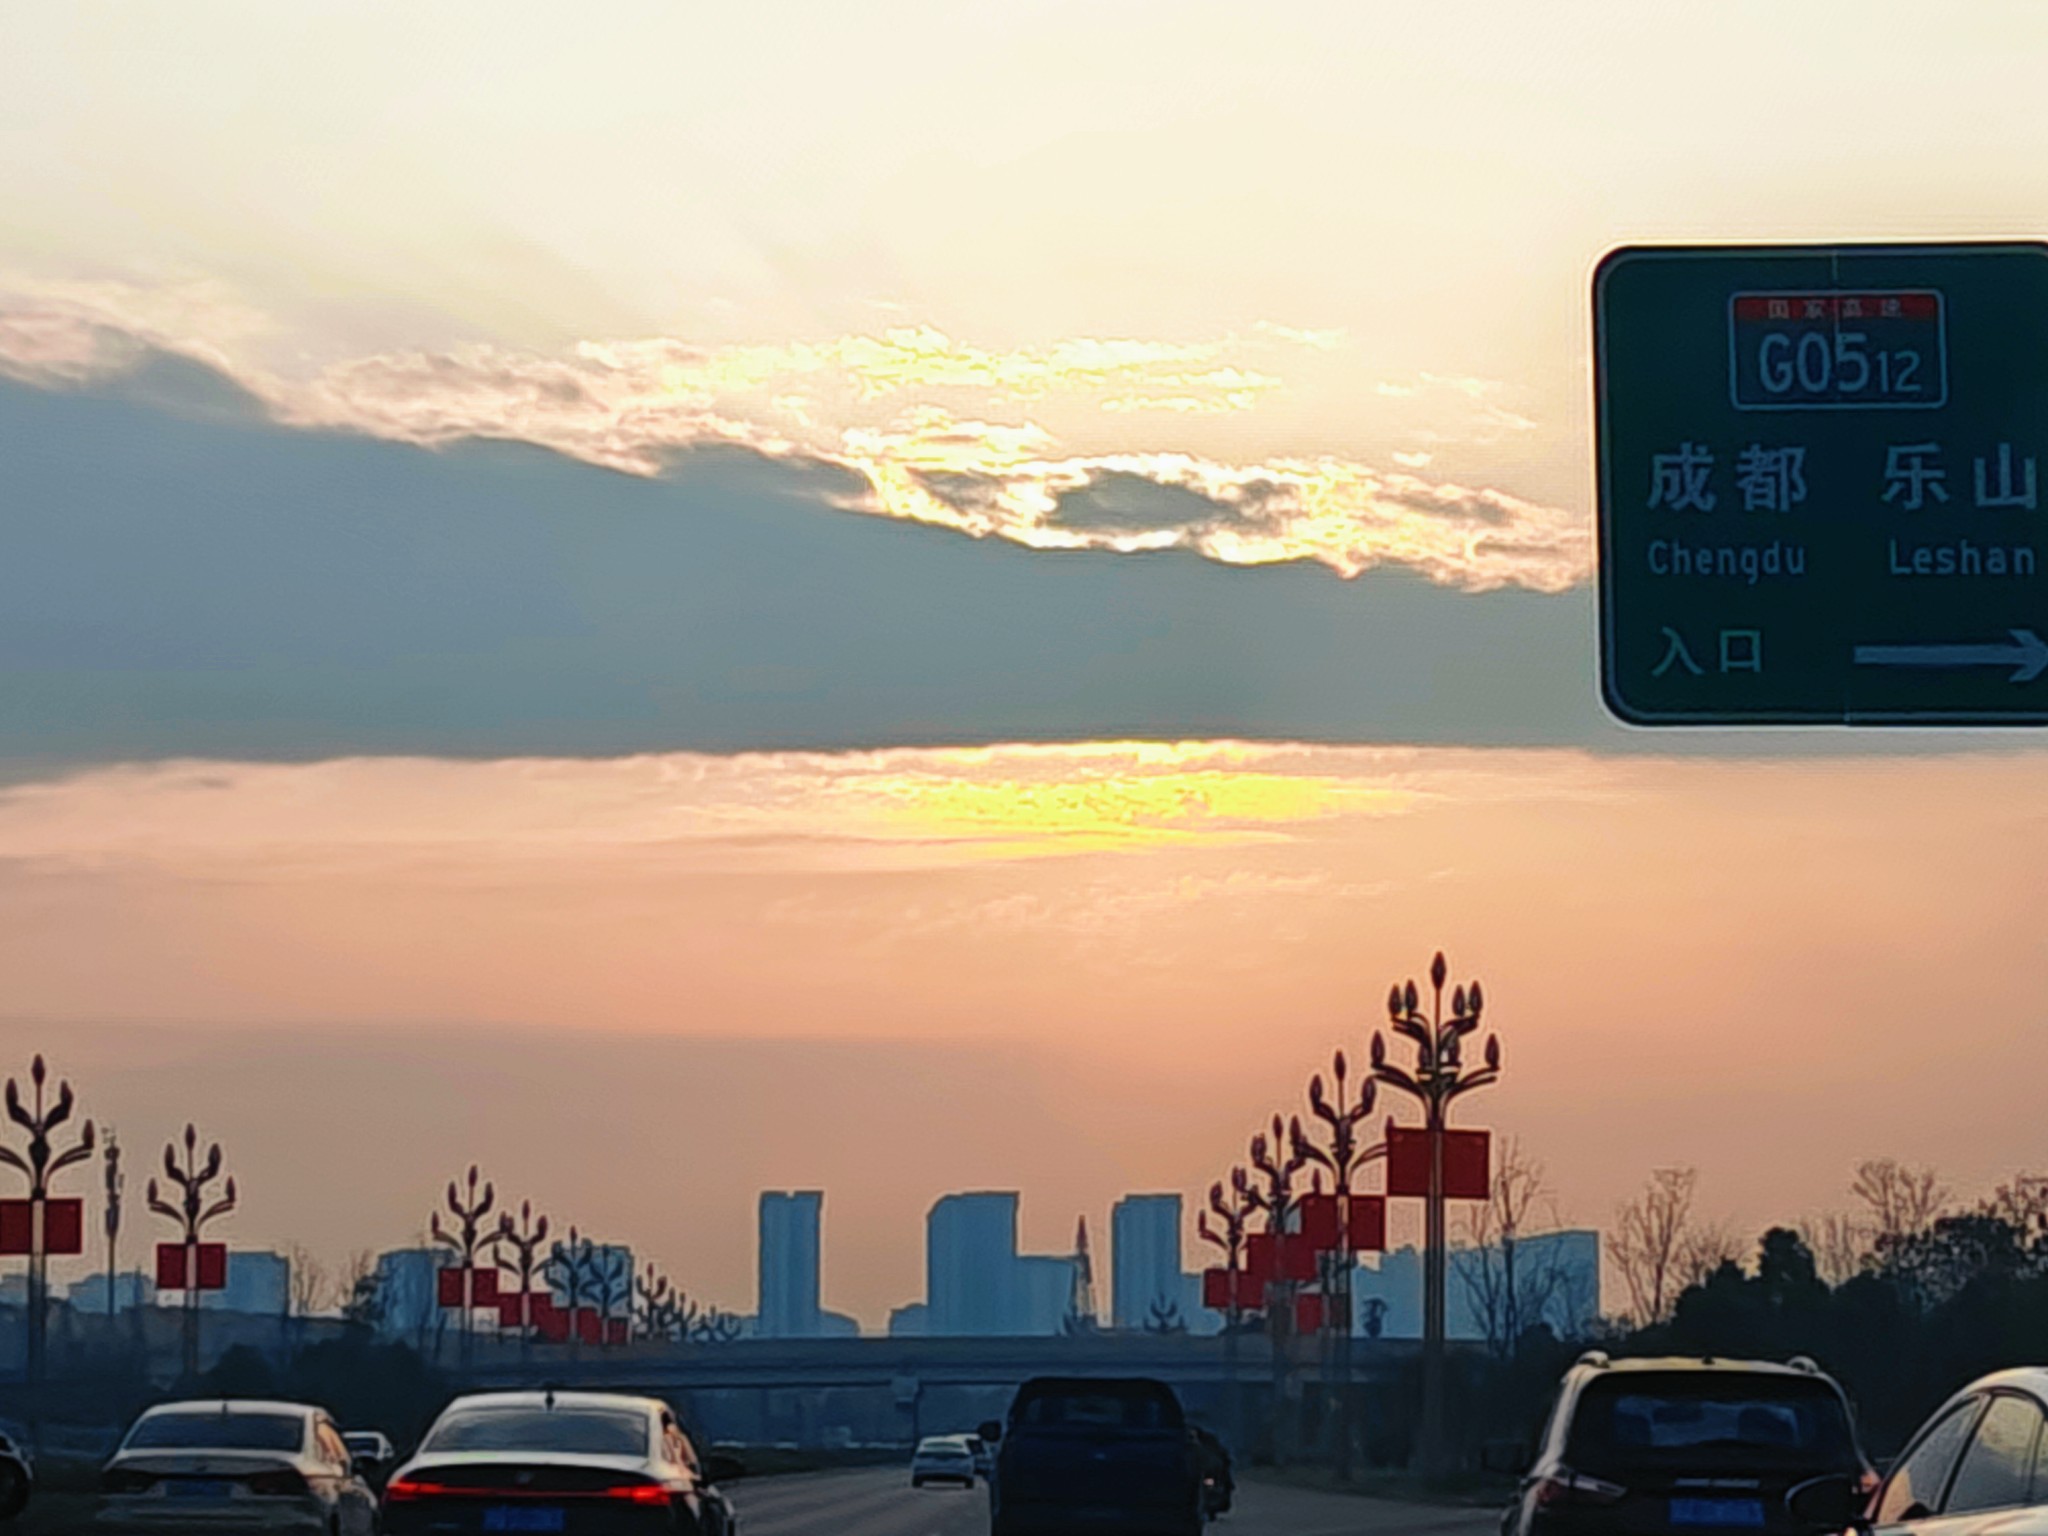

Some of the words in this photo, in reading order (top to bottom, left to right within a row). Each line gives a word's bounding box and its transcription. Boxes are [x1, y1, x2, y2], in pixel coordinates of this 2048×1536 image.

[1759, 331, 1922, 393] G0512
[1647, 442, 1808, 513] 成都
[1881, 443, 2037, 511] 乐山
[1648, 541, 1807, 584] Chengdu
[1890, 540, 2036, 575] Leshan
[1651, 626, 1764, 676] 入口
